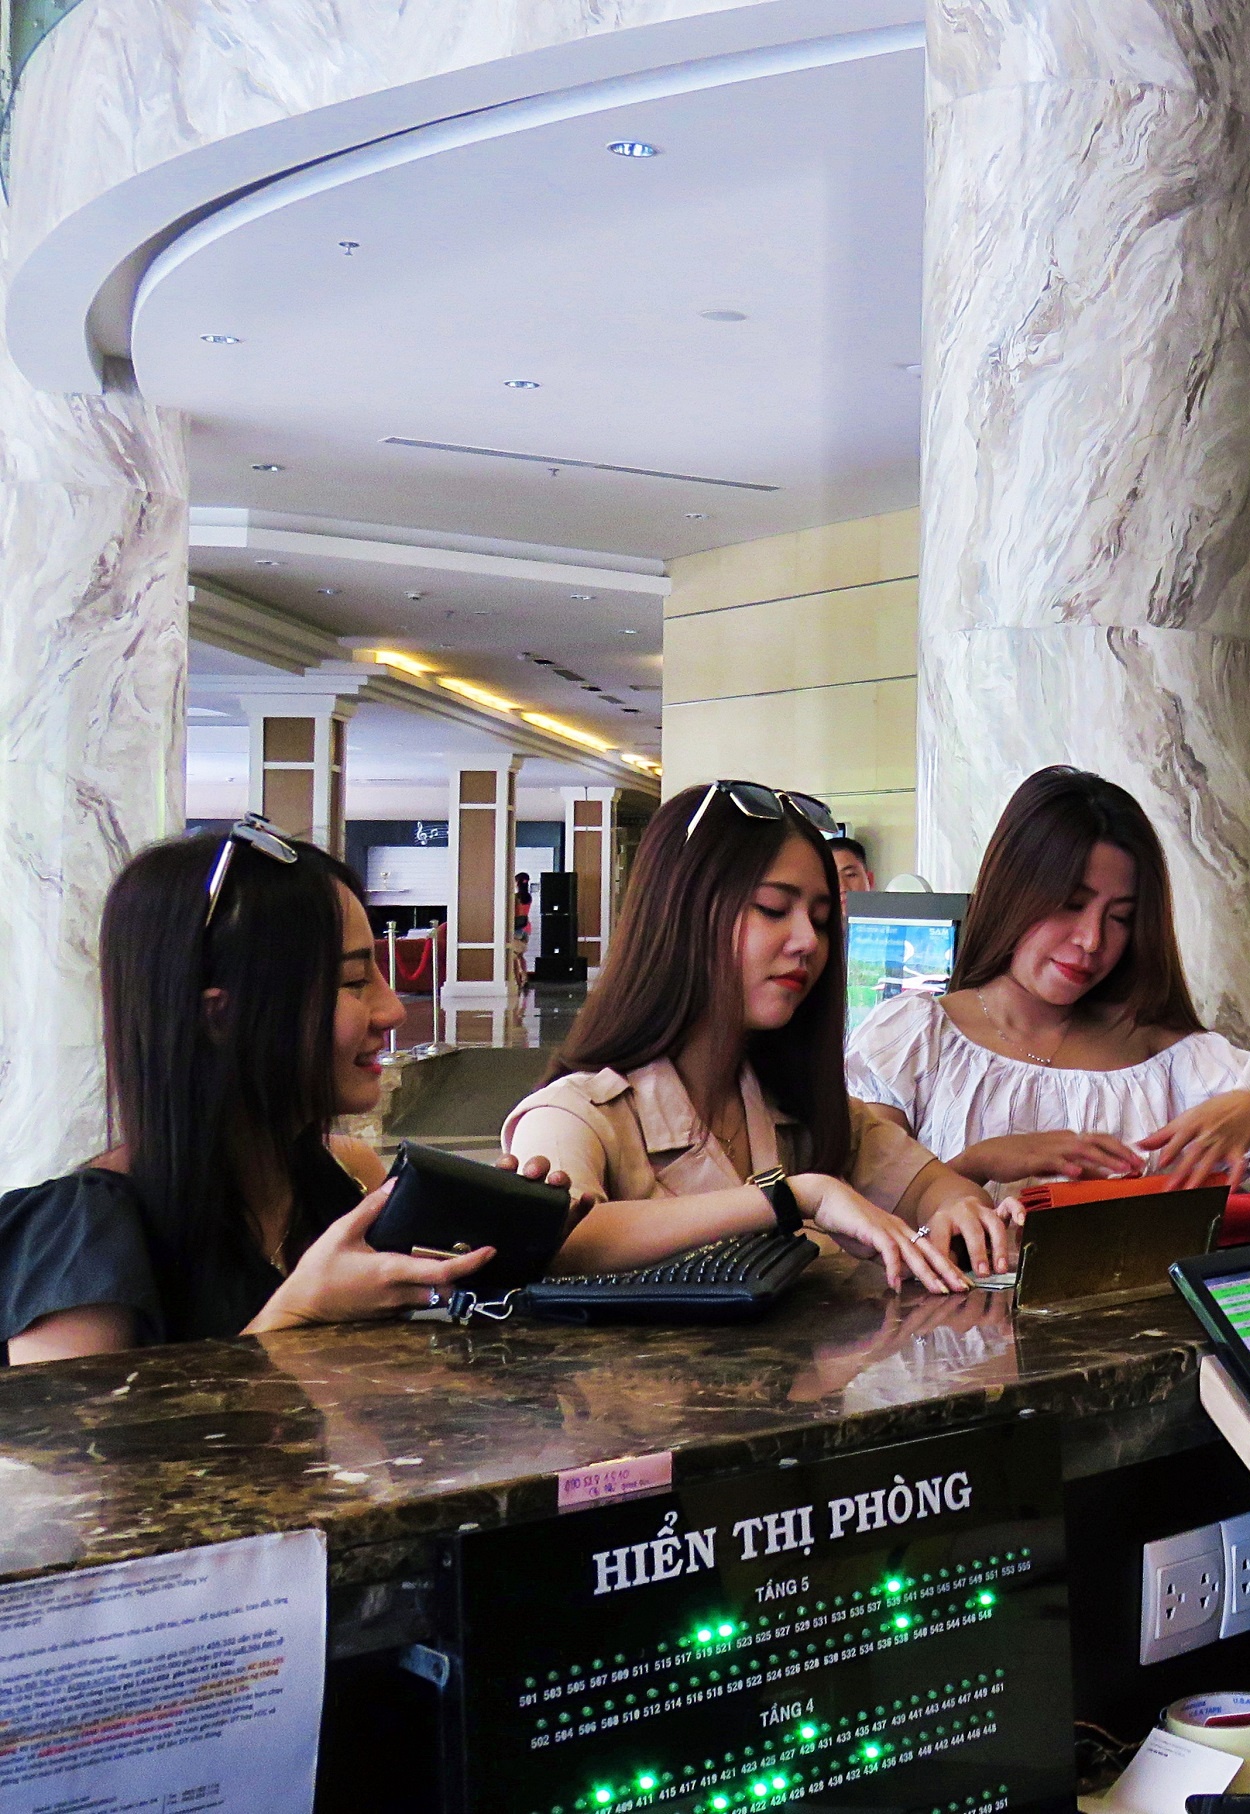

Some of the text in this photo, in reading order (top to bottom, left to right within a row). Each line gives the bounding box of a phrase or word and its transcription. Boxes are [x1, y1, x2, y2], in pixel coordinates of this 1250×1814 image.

[592, 1472, 973, 1596] HIỂN THỊ PHÒNG
[755, 1576, 810, 1603] TẦNG 5
[519, 1693, 537, 1707] 501
[544, 1686, 562, 1700] 503
[567, 1680, 585, 1694] 505
[590, 1674, 607, 1688] 507
[612, 1669, 629, 1682] 509
[632, 1663, 649, 1677] 511
[655, 1657, 671, 1671] 515
[675, 1652, 692, 1665] 517
[695, 1645, 712, 1659] 519
[716, 1640, 731, 1654] 521
[737, 1635, 752, 1648] 523
[756, 1629, 771, 1643] 525
[775, 1625, 790, 1638] 527
[795, 1620, 810, 1633] 529
[813, 1615, 828, 1628] 531
[831, 1610, 846, 1623] 533
[850, 1605, 864, 1618] 535
[867, 1600, 881, 1613] 537
[904, 1591, 917, 1603] 541
[920, 1587, 934, 1598] 543
[937, 1582, 950, 1594] 545
[953, 1578, 966, 1590] 547
[969, 1574, 982, 1585] 549
[985, 1569, 998, 1581] 551
[1002, 1565, 1015, 1576] 553
[531, 1735, 549, 1749] 502
[555, 1728, 573, 1742] 504
[579, 1721, 596, 1735] 506
[623, 1709, 640, 1723] 510
[644, 1704, 660, 1718] 512
[664, 1697, 682, 1711] 514
[687, 1691, 703, 1705] 516
[707, 1686, 723, 1699] 518
[727, 1680, 742, 1693] 520
[746, 1674, 762, 1688] 522
[766, 1669, 782, 1682] 524
[785, 1663, 800, 1677] 526
[804, 1658, 819, 1671] 528
[842, 1648, 856, 1660] 532
[860, 1642, 874, 1655] 534
[930, 1622, 944, 1635] 542
[946, 1618, 960, 1630] 544
[636, 1794, 653, 1807] 411
[659, 1787, 676, 1800] 415
[679, 1780, 697, 1794] 417
[700, 1774, 717, 1787] 419
[720, 1769, 736, 1781] 421
[741, 1761, 757, 1774] 423
[761, 1755, 776, 1768] 425
[780, 1749, 795, 1762] 427
[800, 1744, 815, 1756] 429
[818, 1738, 832, 1749] 431
[837, 1731, 851, 1743] 433
[855, 1726, 869, 1738] 435
[872, 1720, 887, 1732] 437
[892, 1714, 906, 1726] 439
[908, 1709, 922, 1720] 441
[925, 1704, 939, 1715] 443
[942, 1698, 955, 1710] 445
[958, 1693, 971, 1705] 447
[974, 1688, 987, 1700] 449
[760, 1697, 814, 1728] TẦNG 4
[751, 1801, 766, 1813] 422
[771, 1795, 786, 1807] 424
[846, 1769, 860, 1781] 432
[863, 1763, 878, 1775] 434
[935, 1739, 948, 1751] 442
[951, 1734, 964, 1745] 444
